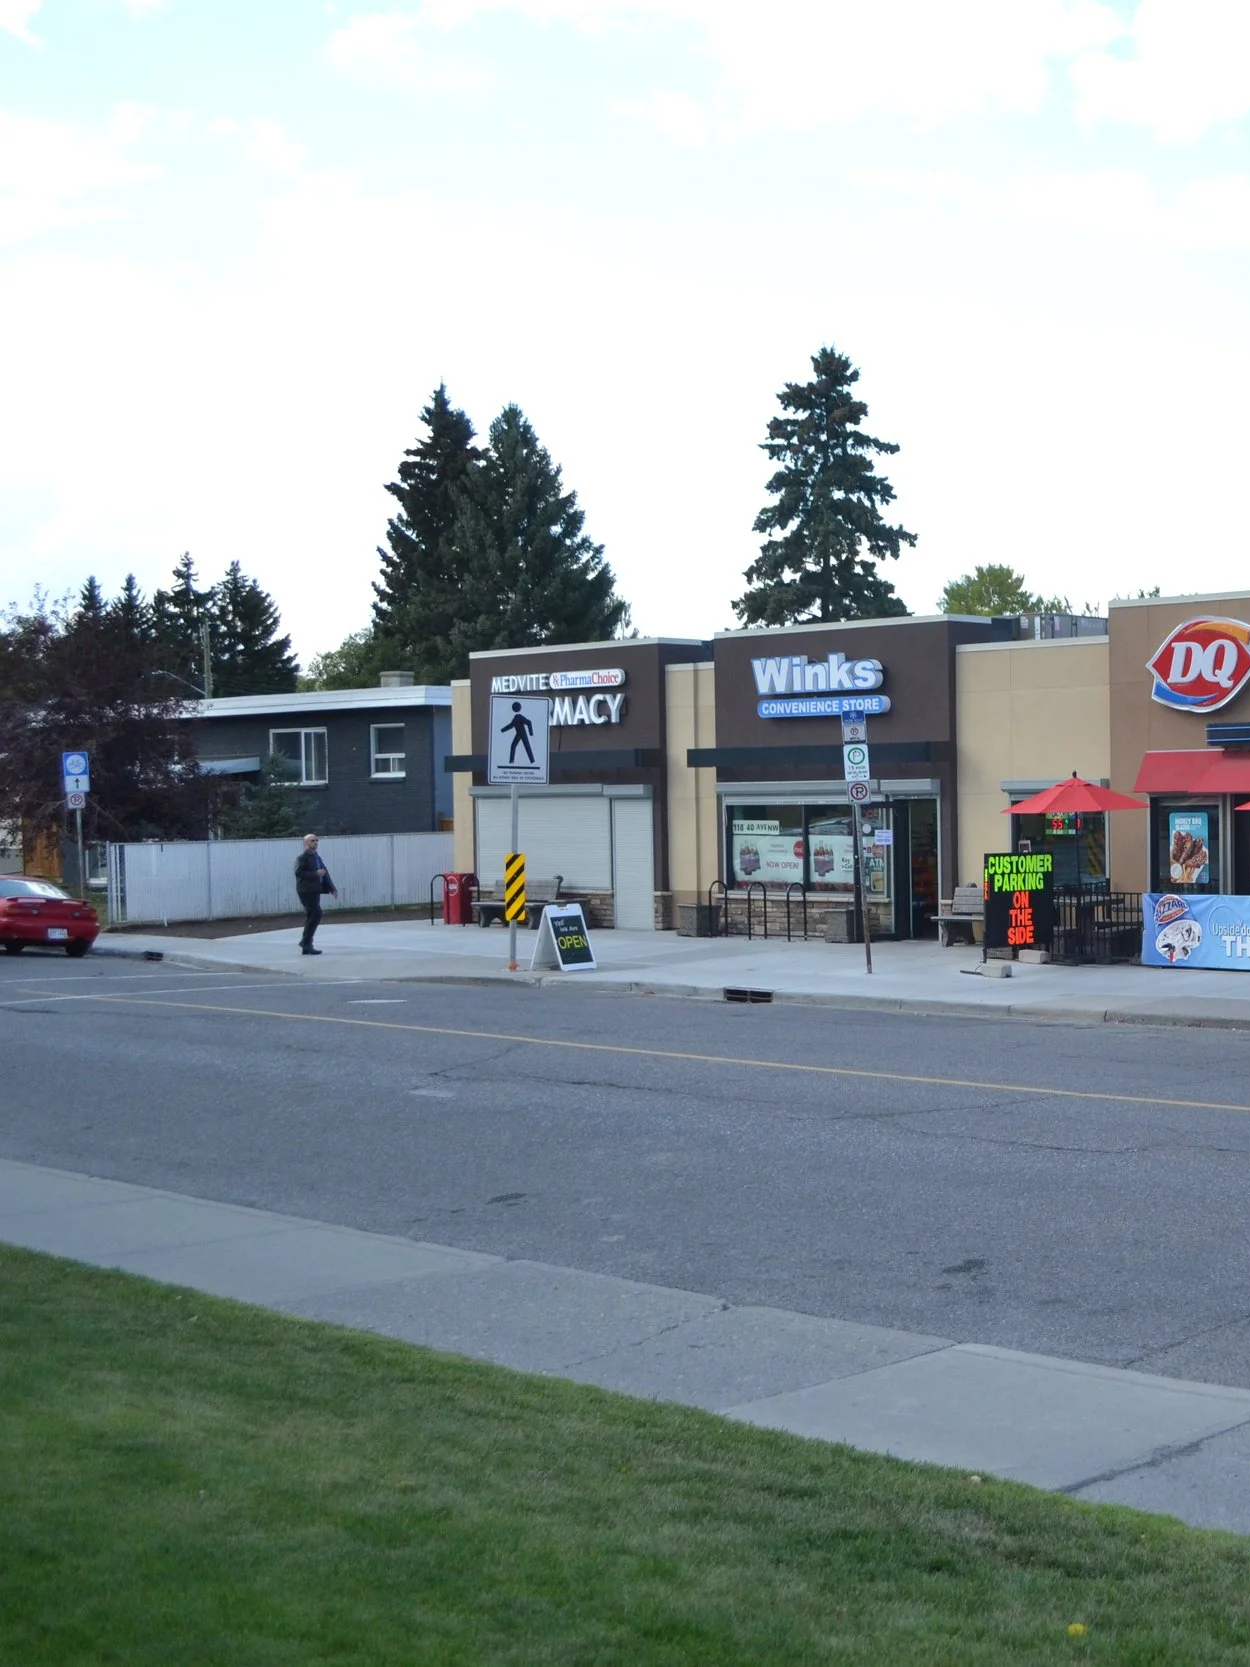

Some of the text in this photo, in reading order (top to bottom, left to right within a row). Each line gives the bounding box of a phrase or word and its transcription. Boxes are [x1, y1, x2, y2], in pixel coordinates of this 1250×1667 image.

[1167, 638, 1239, 688] DQ
[751, 652, 881, 695] Winks
[491, 672, 549, 694] MEDVITE
[762, 698, 880, 714] CONVENIENCE STORE
[988, 854, 1053, 874] CUSTOMER
[994, 873, 1044, 892] PARKING
[1013, 891, 1029, 908] ON
[1009, 908, 1033, 926] THE
[557, 935, 588, 950] OPEN
[1007, 926, 1034, 944] SIDE
